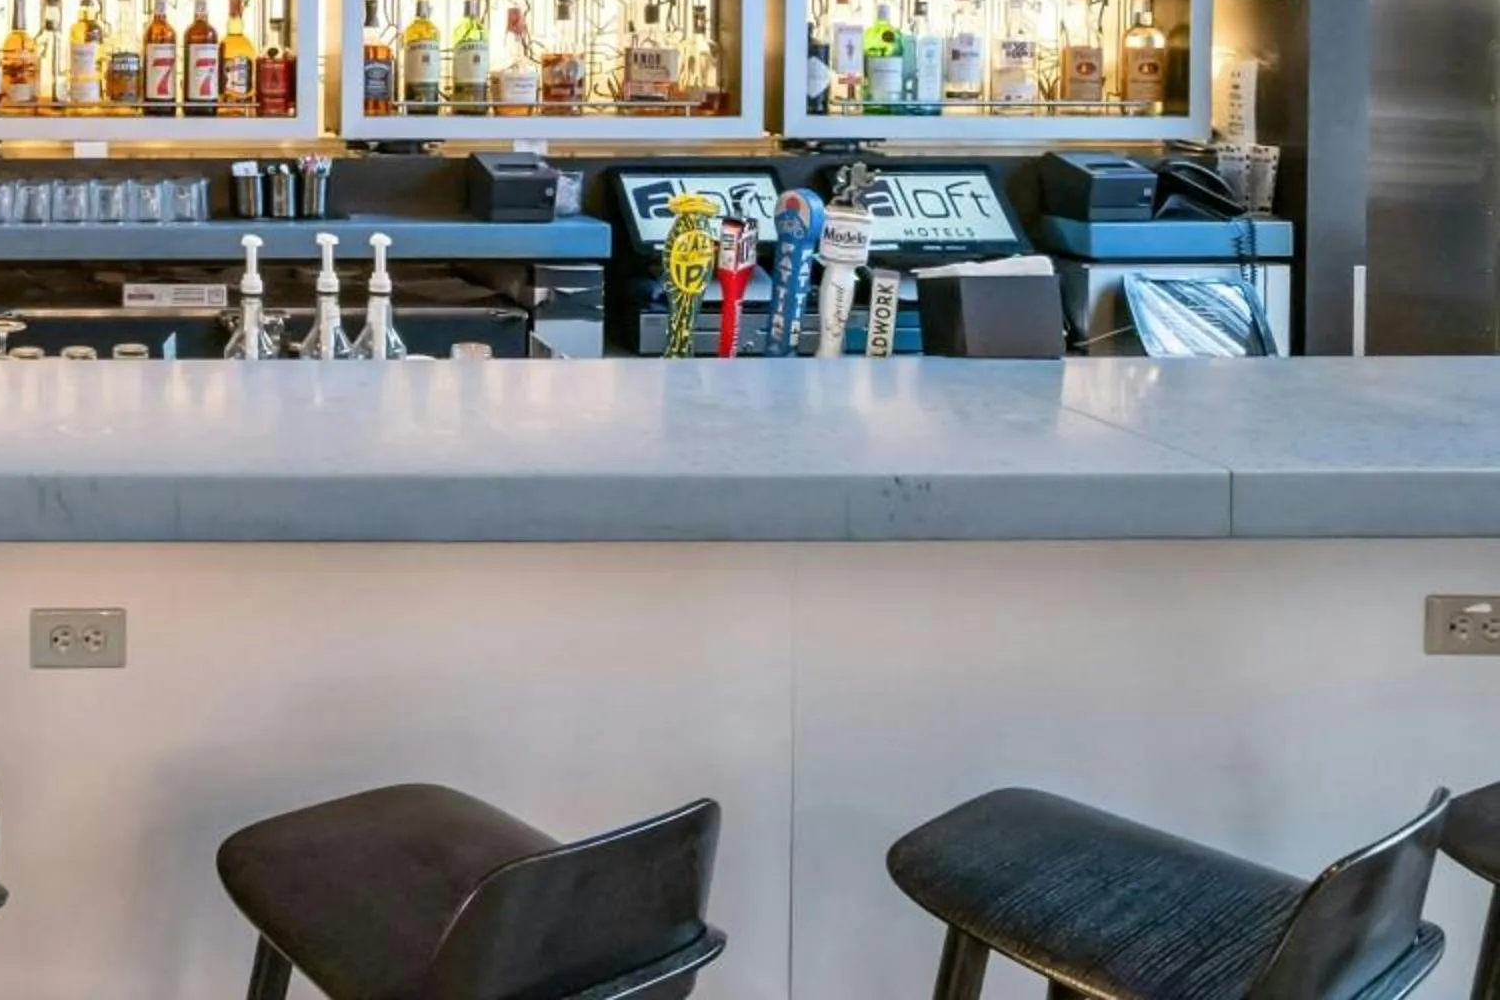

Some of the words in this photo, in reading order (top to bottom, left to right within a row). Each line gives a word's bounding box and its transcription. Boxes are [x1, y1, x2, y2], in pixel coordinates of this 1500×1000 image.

[152, 58, 175, 96] 7
[195, 58, 216, 96] 7
[858, 178, 990, 219] aloft
[903, 227, 976, 238] HOTELS
